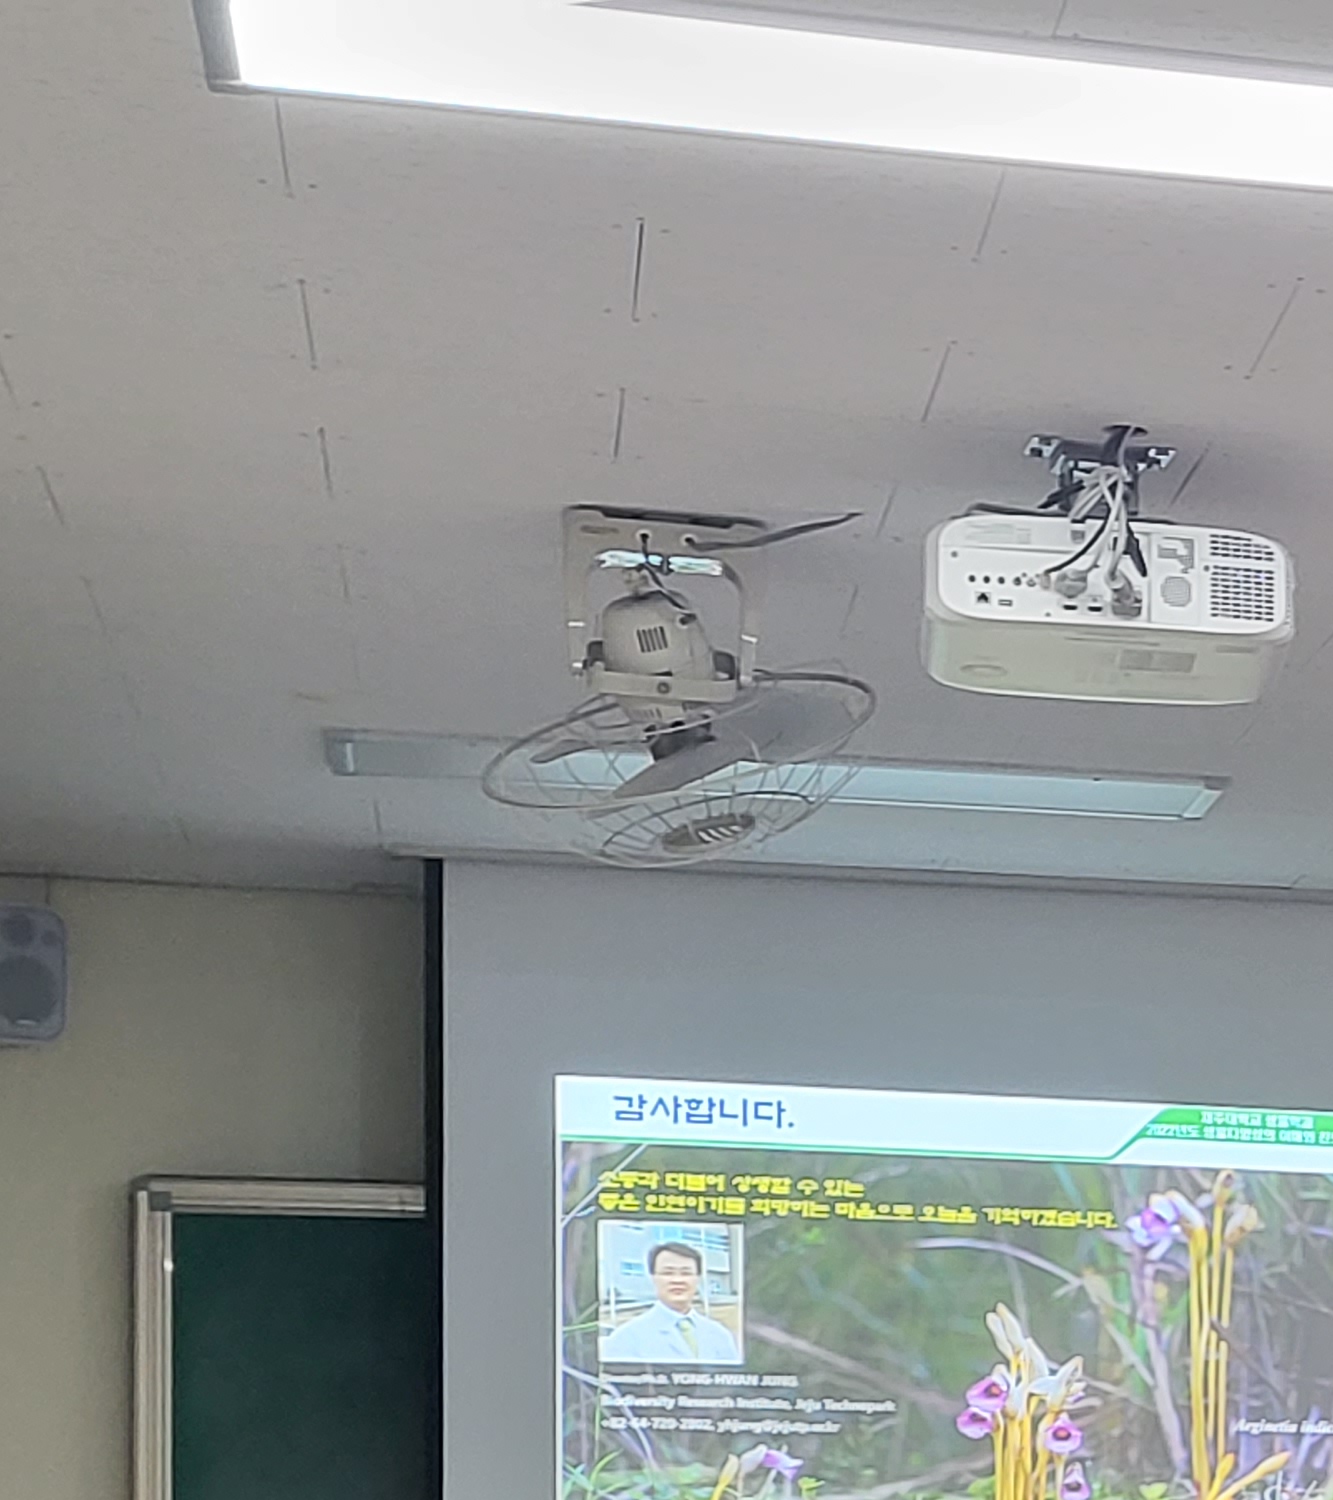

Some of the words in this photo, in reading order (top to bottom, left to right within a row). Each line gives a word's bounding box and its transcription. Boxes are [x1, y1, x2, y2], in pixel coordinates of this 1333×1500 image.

[613, 1094, 794, 1129] 감사합니다.
[796, 1178, 820, 1196] 수
[823, 1179, 865, 1198] 있는
[598, 1192, 641, 1212] 좋은
